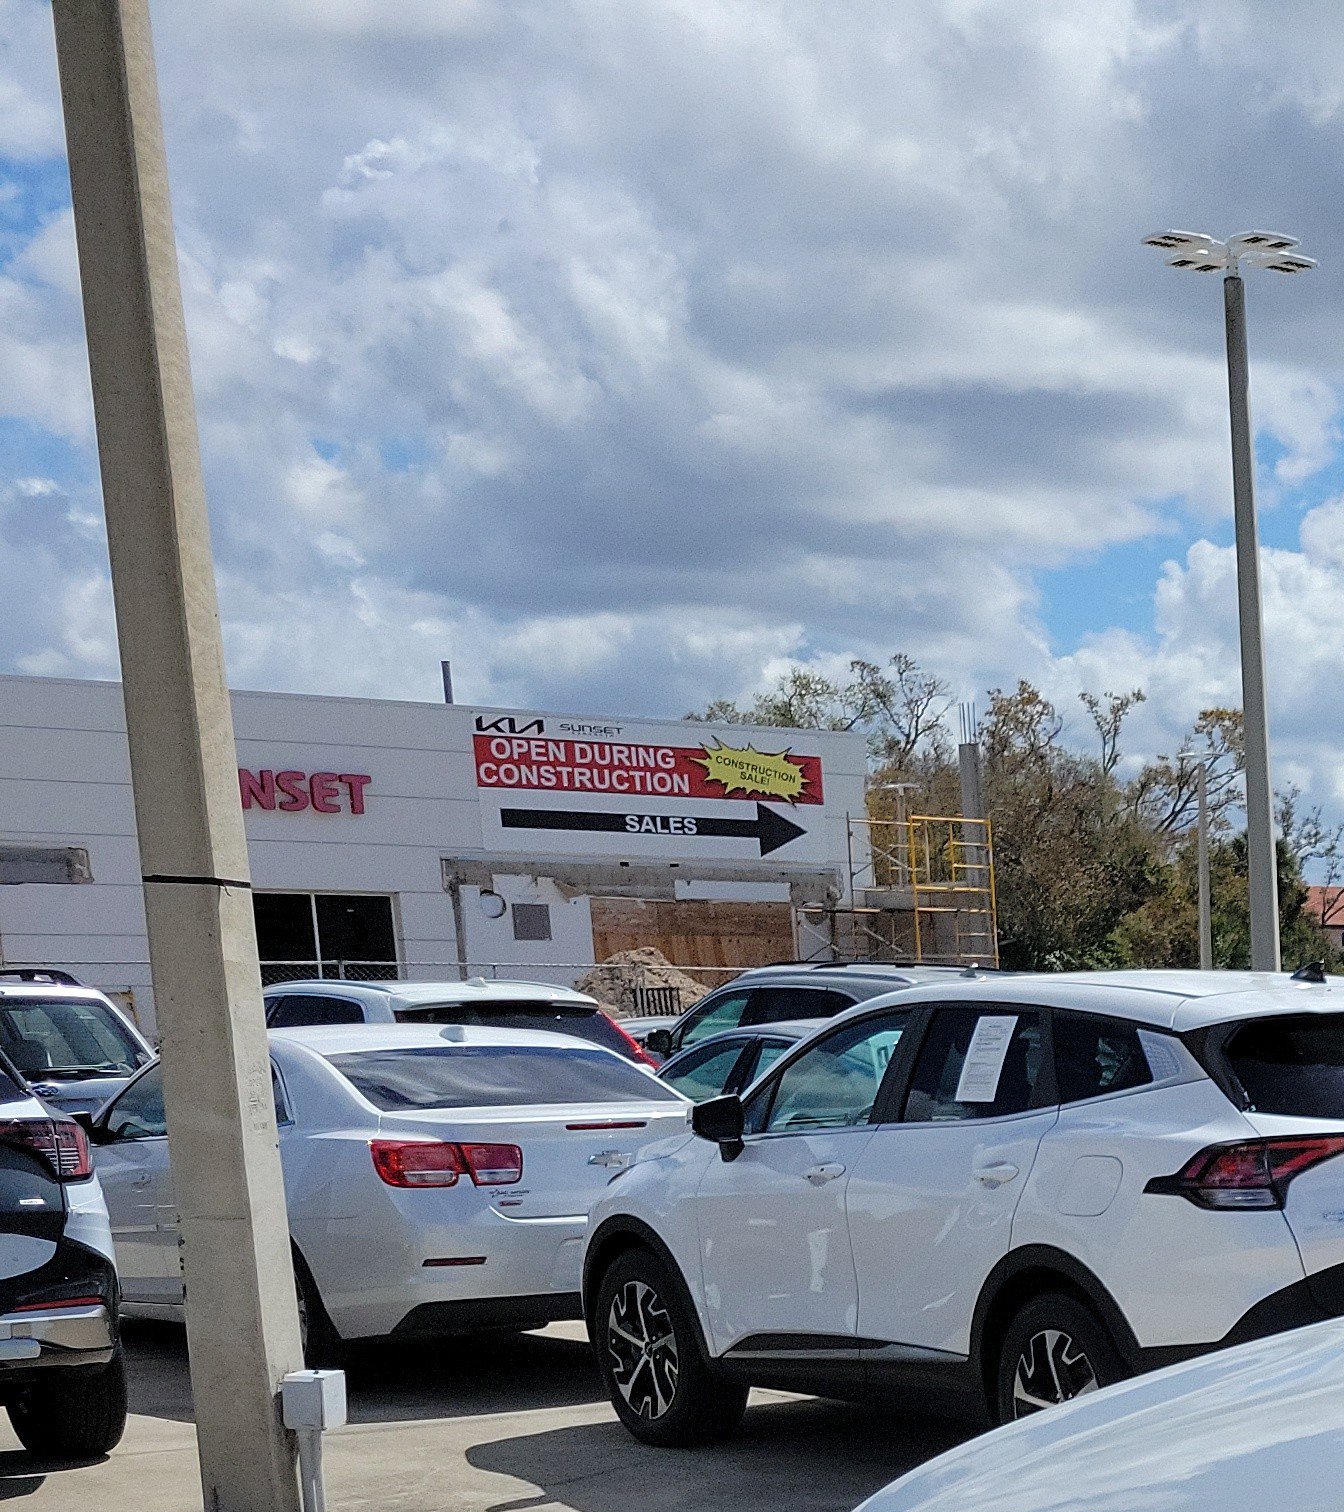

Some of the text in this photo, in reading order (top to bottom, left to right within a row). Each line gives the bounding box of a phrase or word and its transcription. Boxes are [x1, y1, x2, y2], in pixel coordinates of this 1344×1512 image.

[475, 716, 545, 735] KIA
[559, 723, 624, 735] SUNSET
[490, 739, 676, 769] OPEN DURING
[478, 762, 690, 794] CONSTRUCTION
[715, 755, 796, 783] CONSTRUCTION
[238, 768, 372, 815] NSET
[625, 815, 697, 834] SALES
